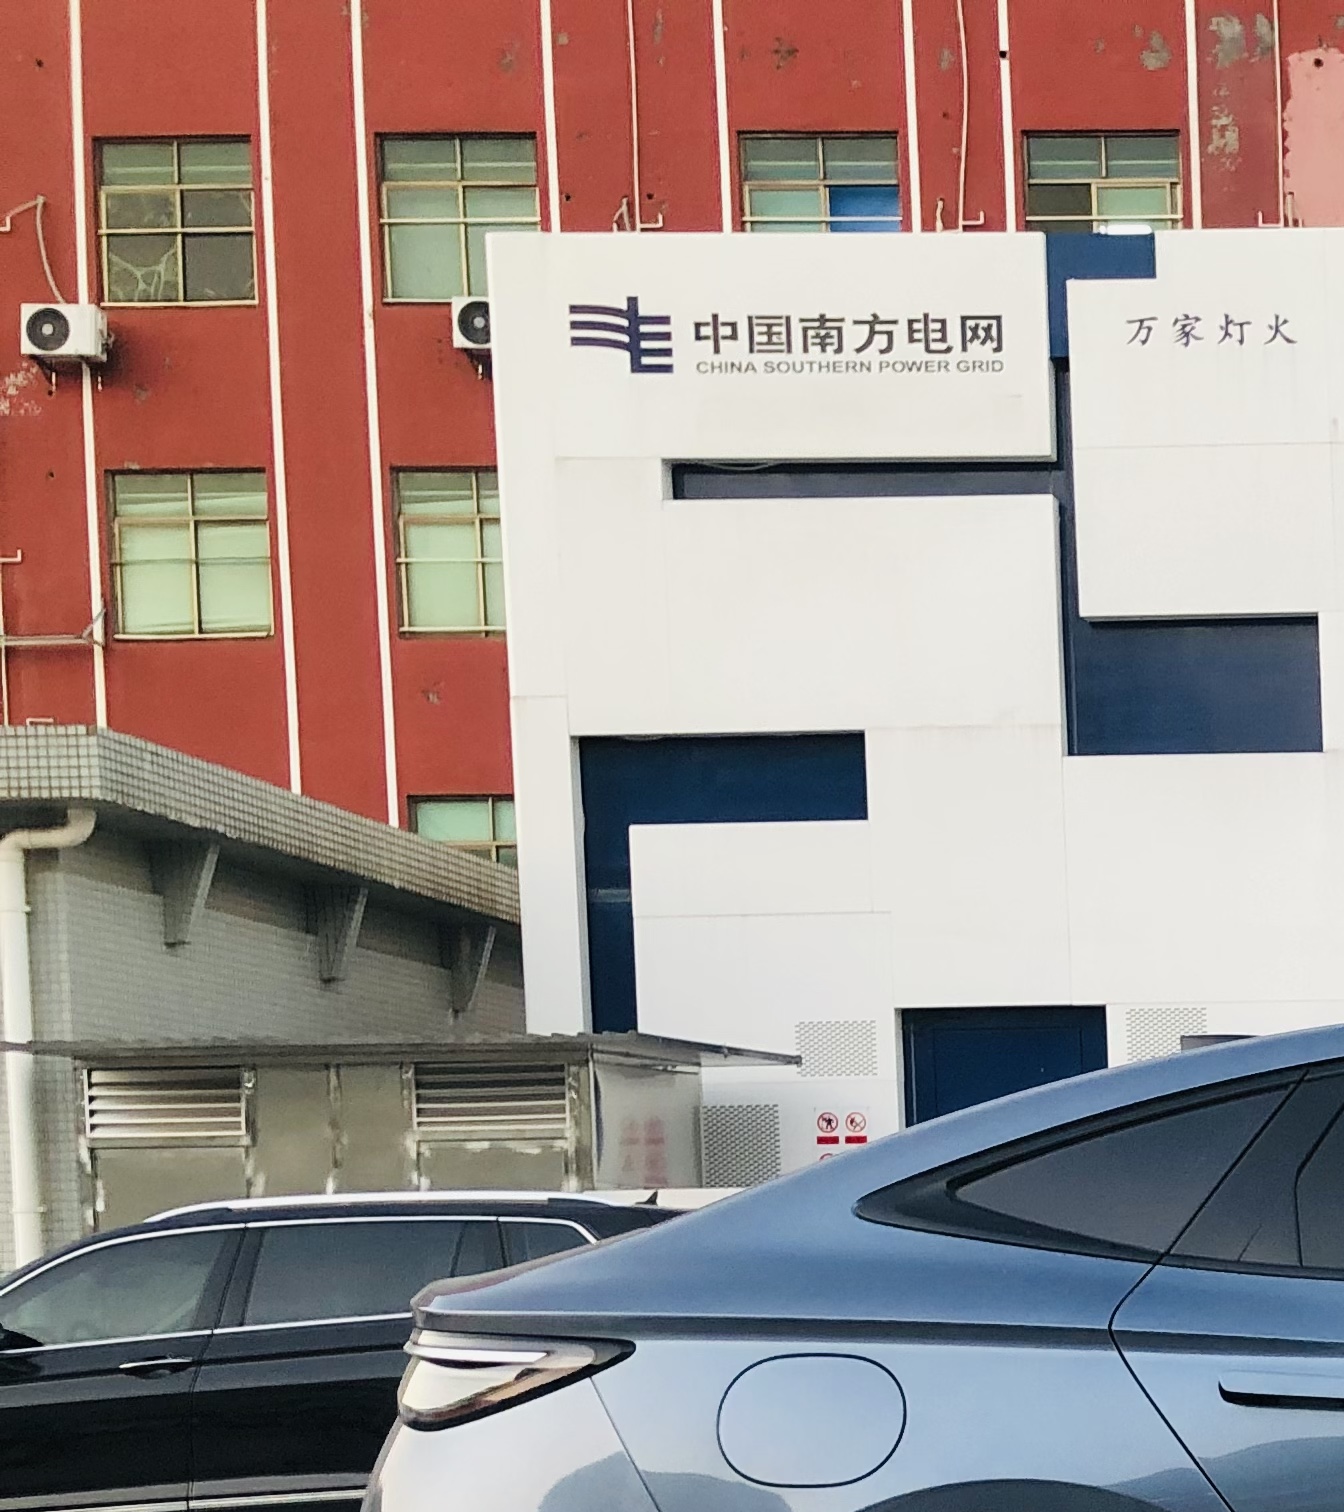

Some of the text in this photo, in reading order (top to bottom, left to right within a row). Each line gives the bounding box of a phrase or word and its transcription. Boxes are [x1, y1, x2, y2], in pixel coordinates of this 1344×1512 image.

[693, 312, 1003, 354] 中国南方电网
[1126, 312, 1298, 347] 万家灯火
[696, 360, 1004, 374] CHINA SOUTHERN POWER GRID
